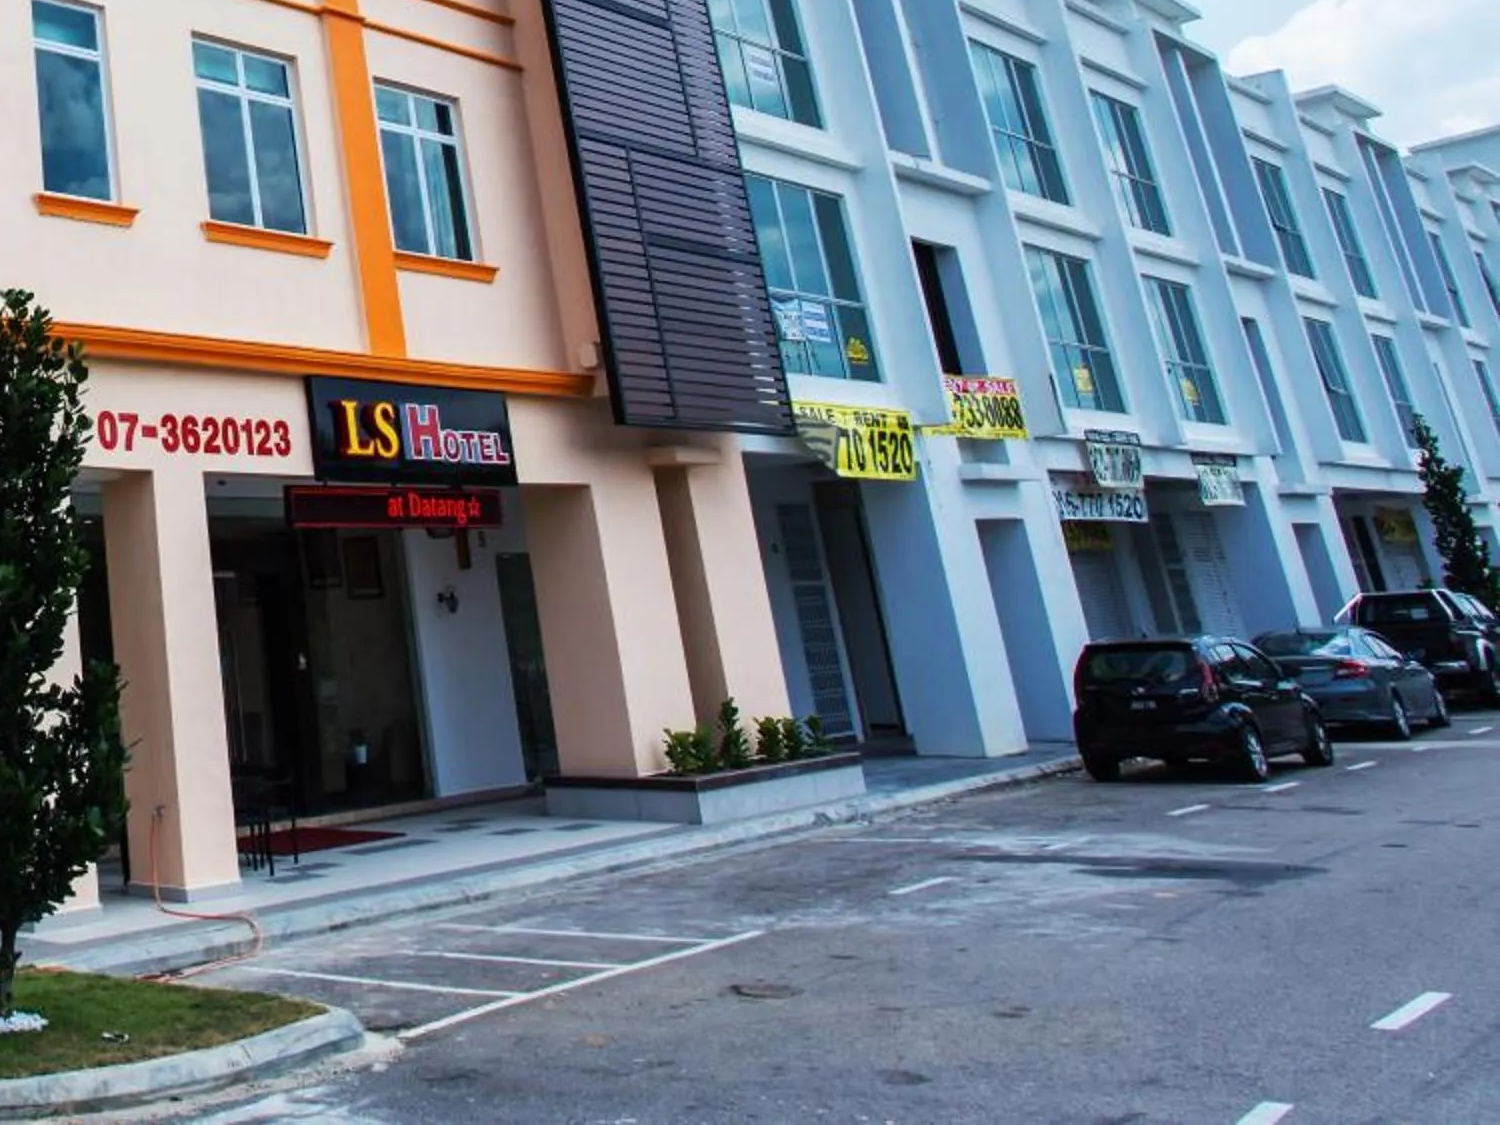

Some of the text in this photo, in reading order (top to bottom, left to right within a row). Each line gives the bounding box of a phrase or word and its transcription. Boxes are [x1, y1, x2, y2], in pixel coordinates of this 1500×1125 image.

[97, 410, 291, 457] 07-3620123
[336, 398, 400, 460] LS
[853, 410, 888, 428] RENT
[868, 428, 914, 474] 1520
[407, 490, 468, 525] Datang
[1107, 491, 1144, 520] 1520
